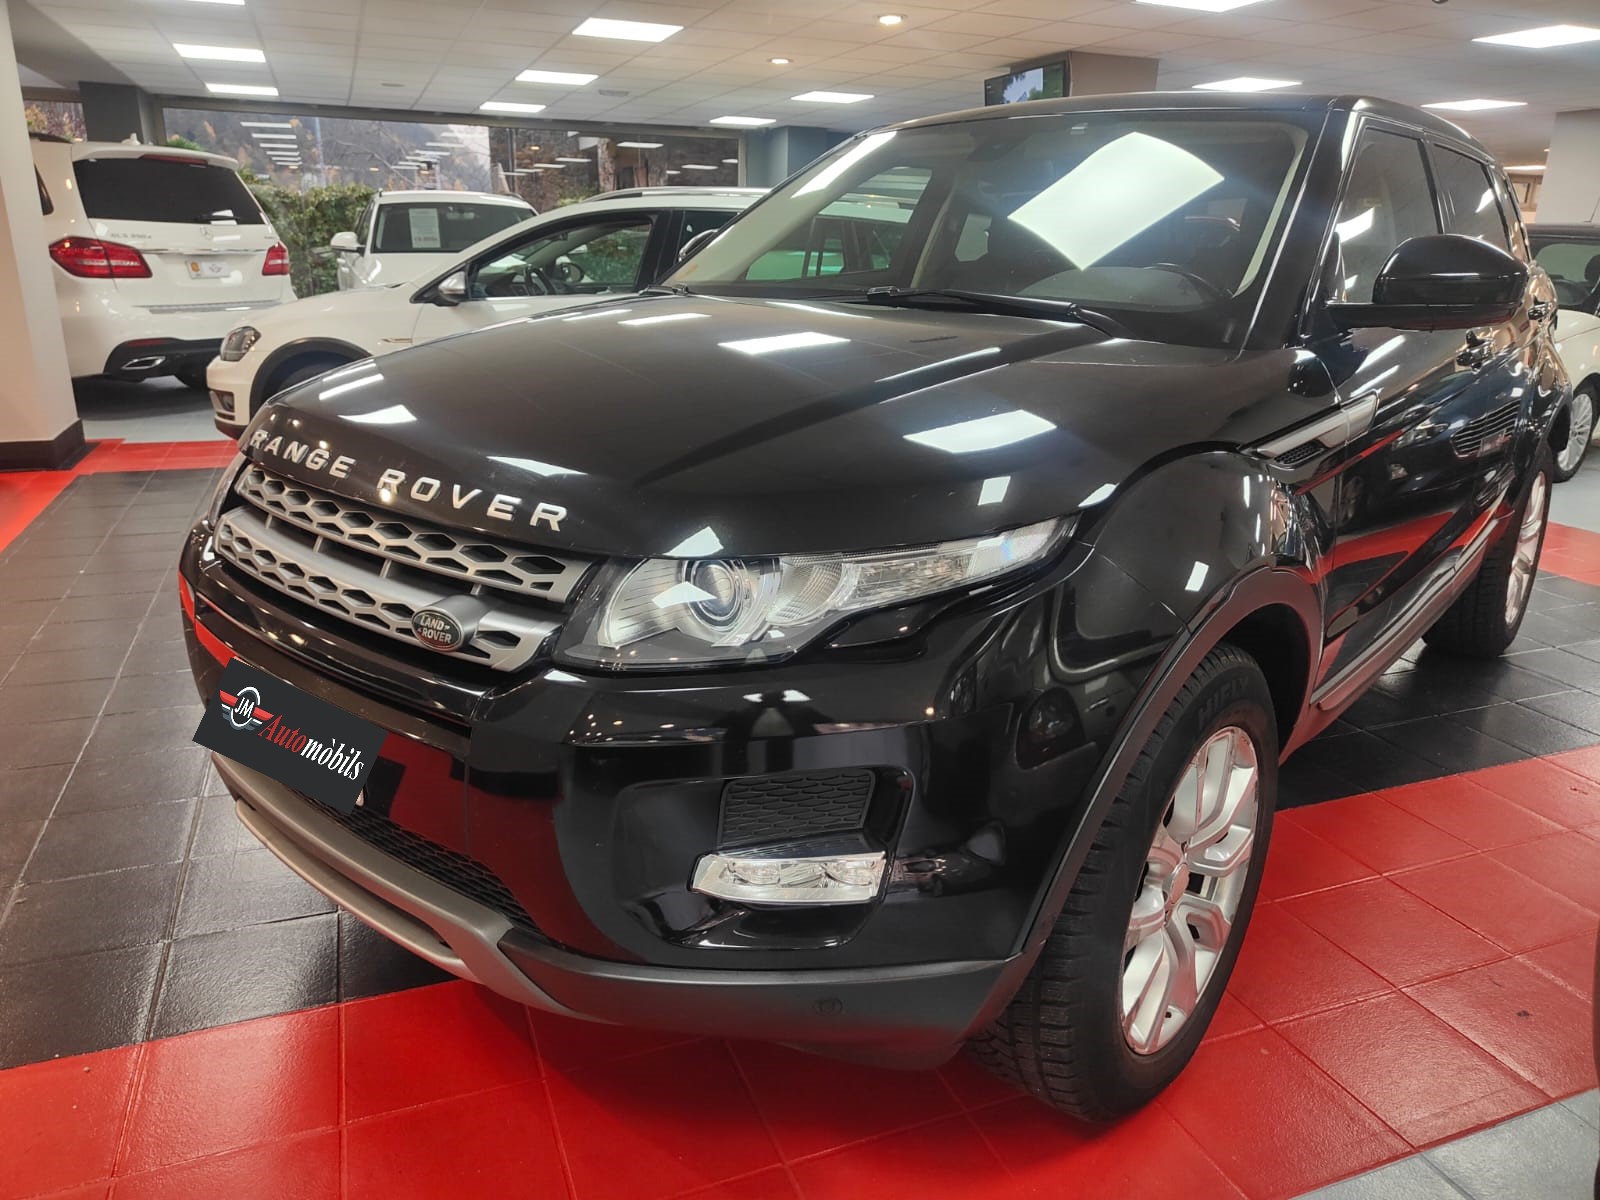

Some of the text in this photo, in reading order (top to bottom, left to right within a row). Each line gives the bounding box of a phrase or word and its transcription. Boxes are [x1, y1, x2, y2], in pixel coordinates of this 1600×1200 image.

[250, 429, 568, 532] RANGE ROVER
[420, 615, 445, 631] LAND
[421, 627, 452, 643] ROVER
